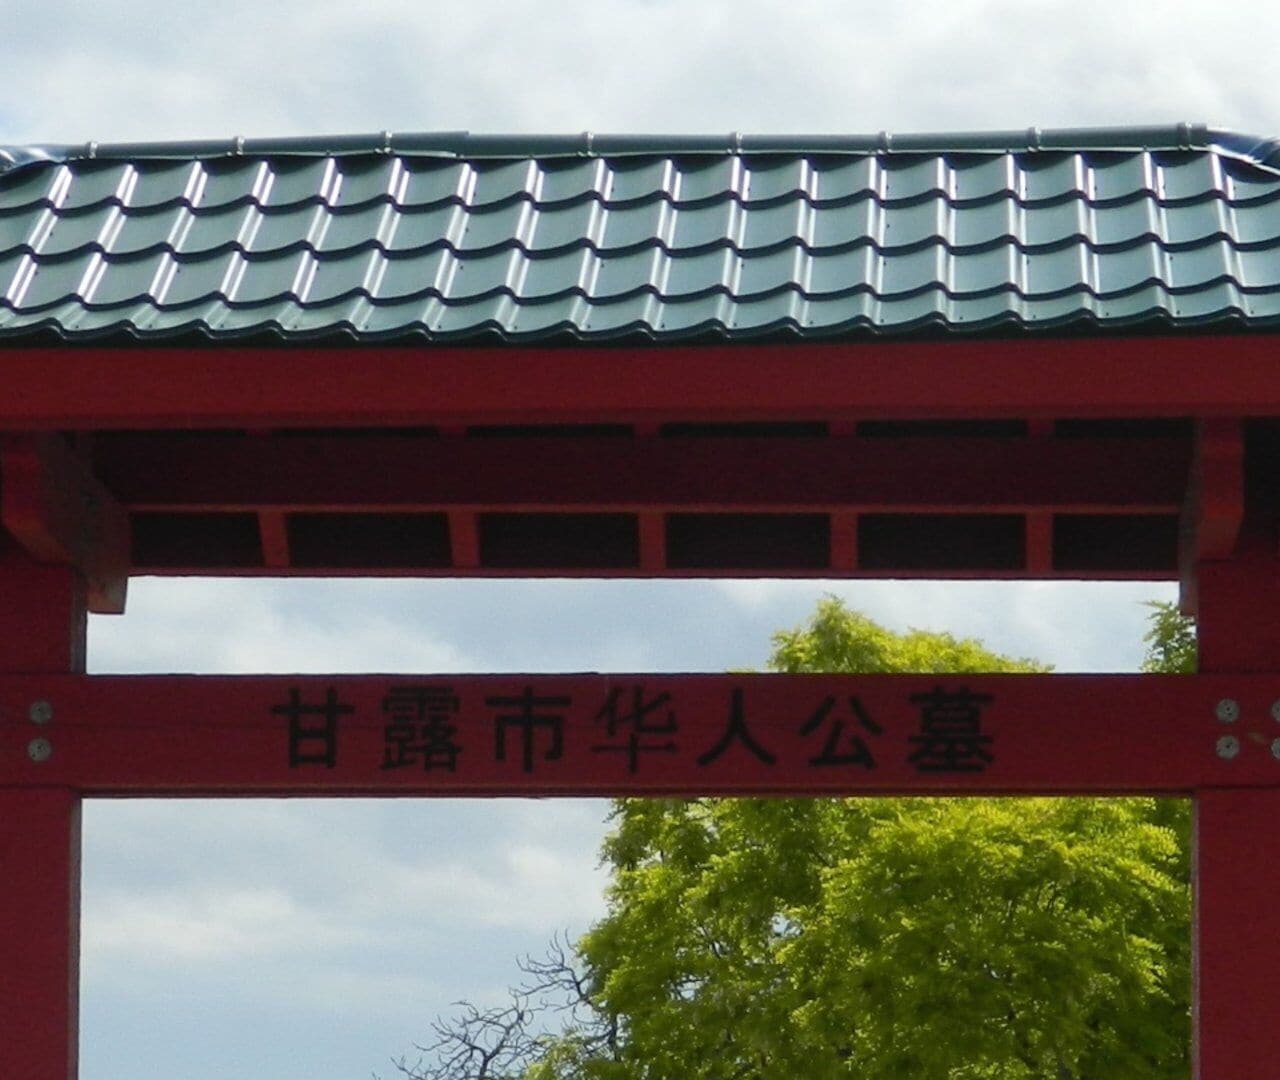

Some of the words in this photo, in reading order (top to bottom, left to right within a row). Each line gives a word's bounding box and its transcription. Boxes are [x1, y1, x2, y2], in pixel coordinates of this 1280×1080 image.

[271, 685, 995, 773] 甘露市华人公墓
